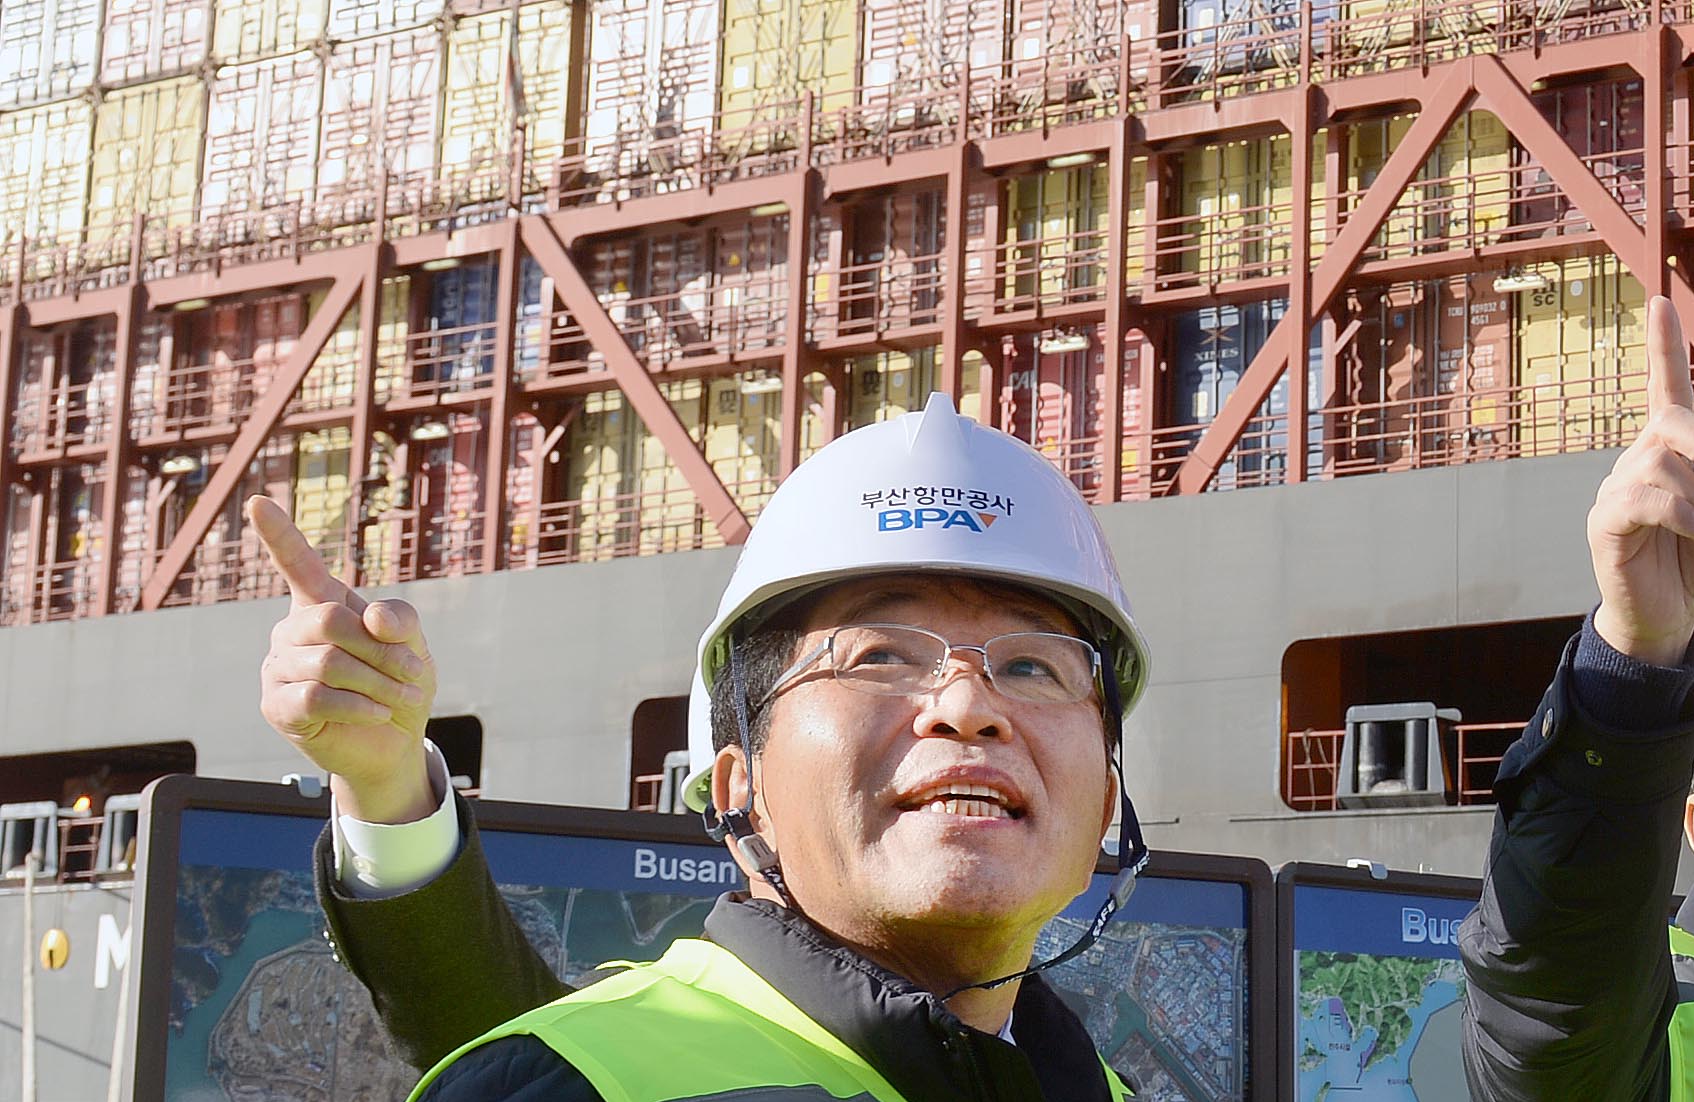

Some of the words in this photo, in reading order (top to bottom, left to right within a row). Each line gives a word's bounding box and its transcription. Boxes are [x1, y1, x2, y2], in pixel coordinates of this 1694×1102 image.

[860, 485, 1015, 517] 부산항만공사
[878, 507, 984, 533] BPA
[634, 848, 737, 884] Busan
